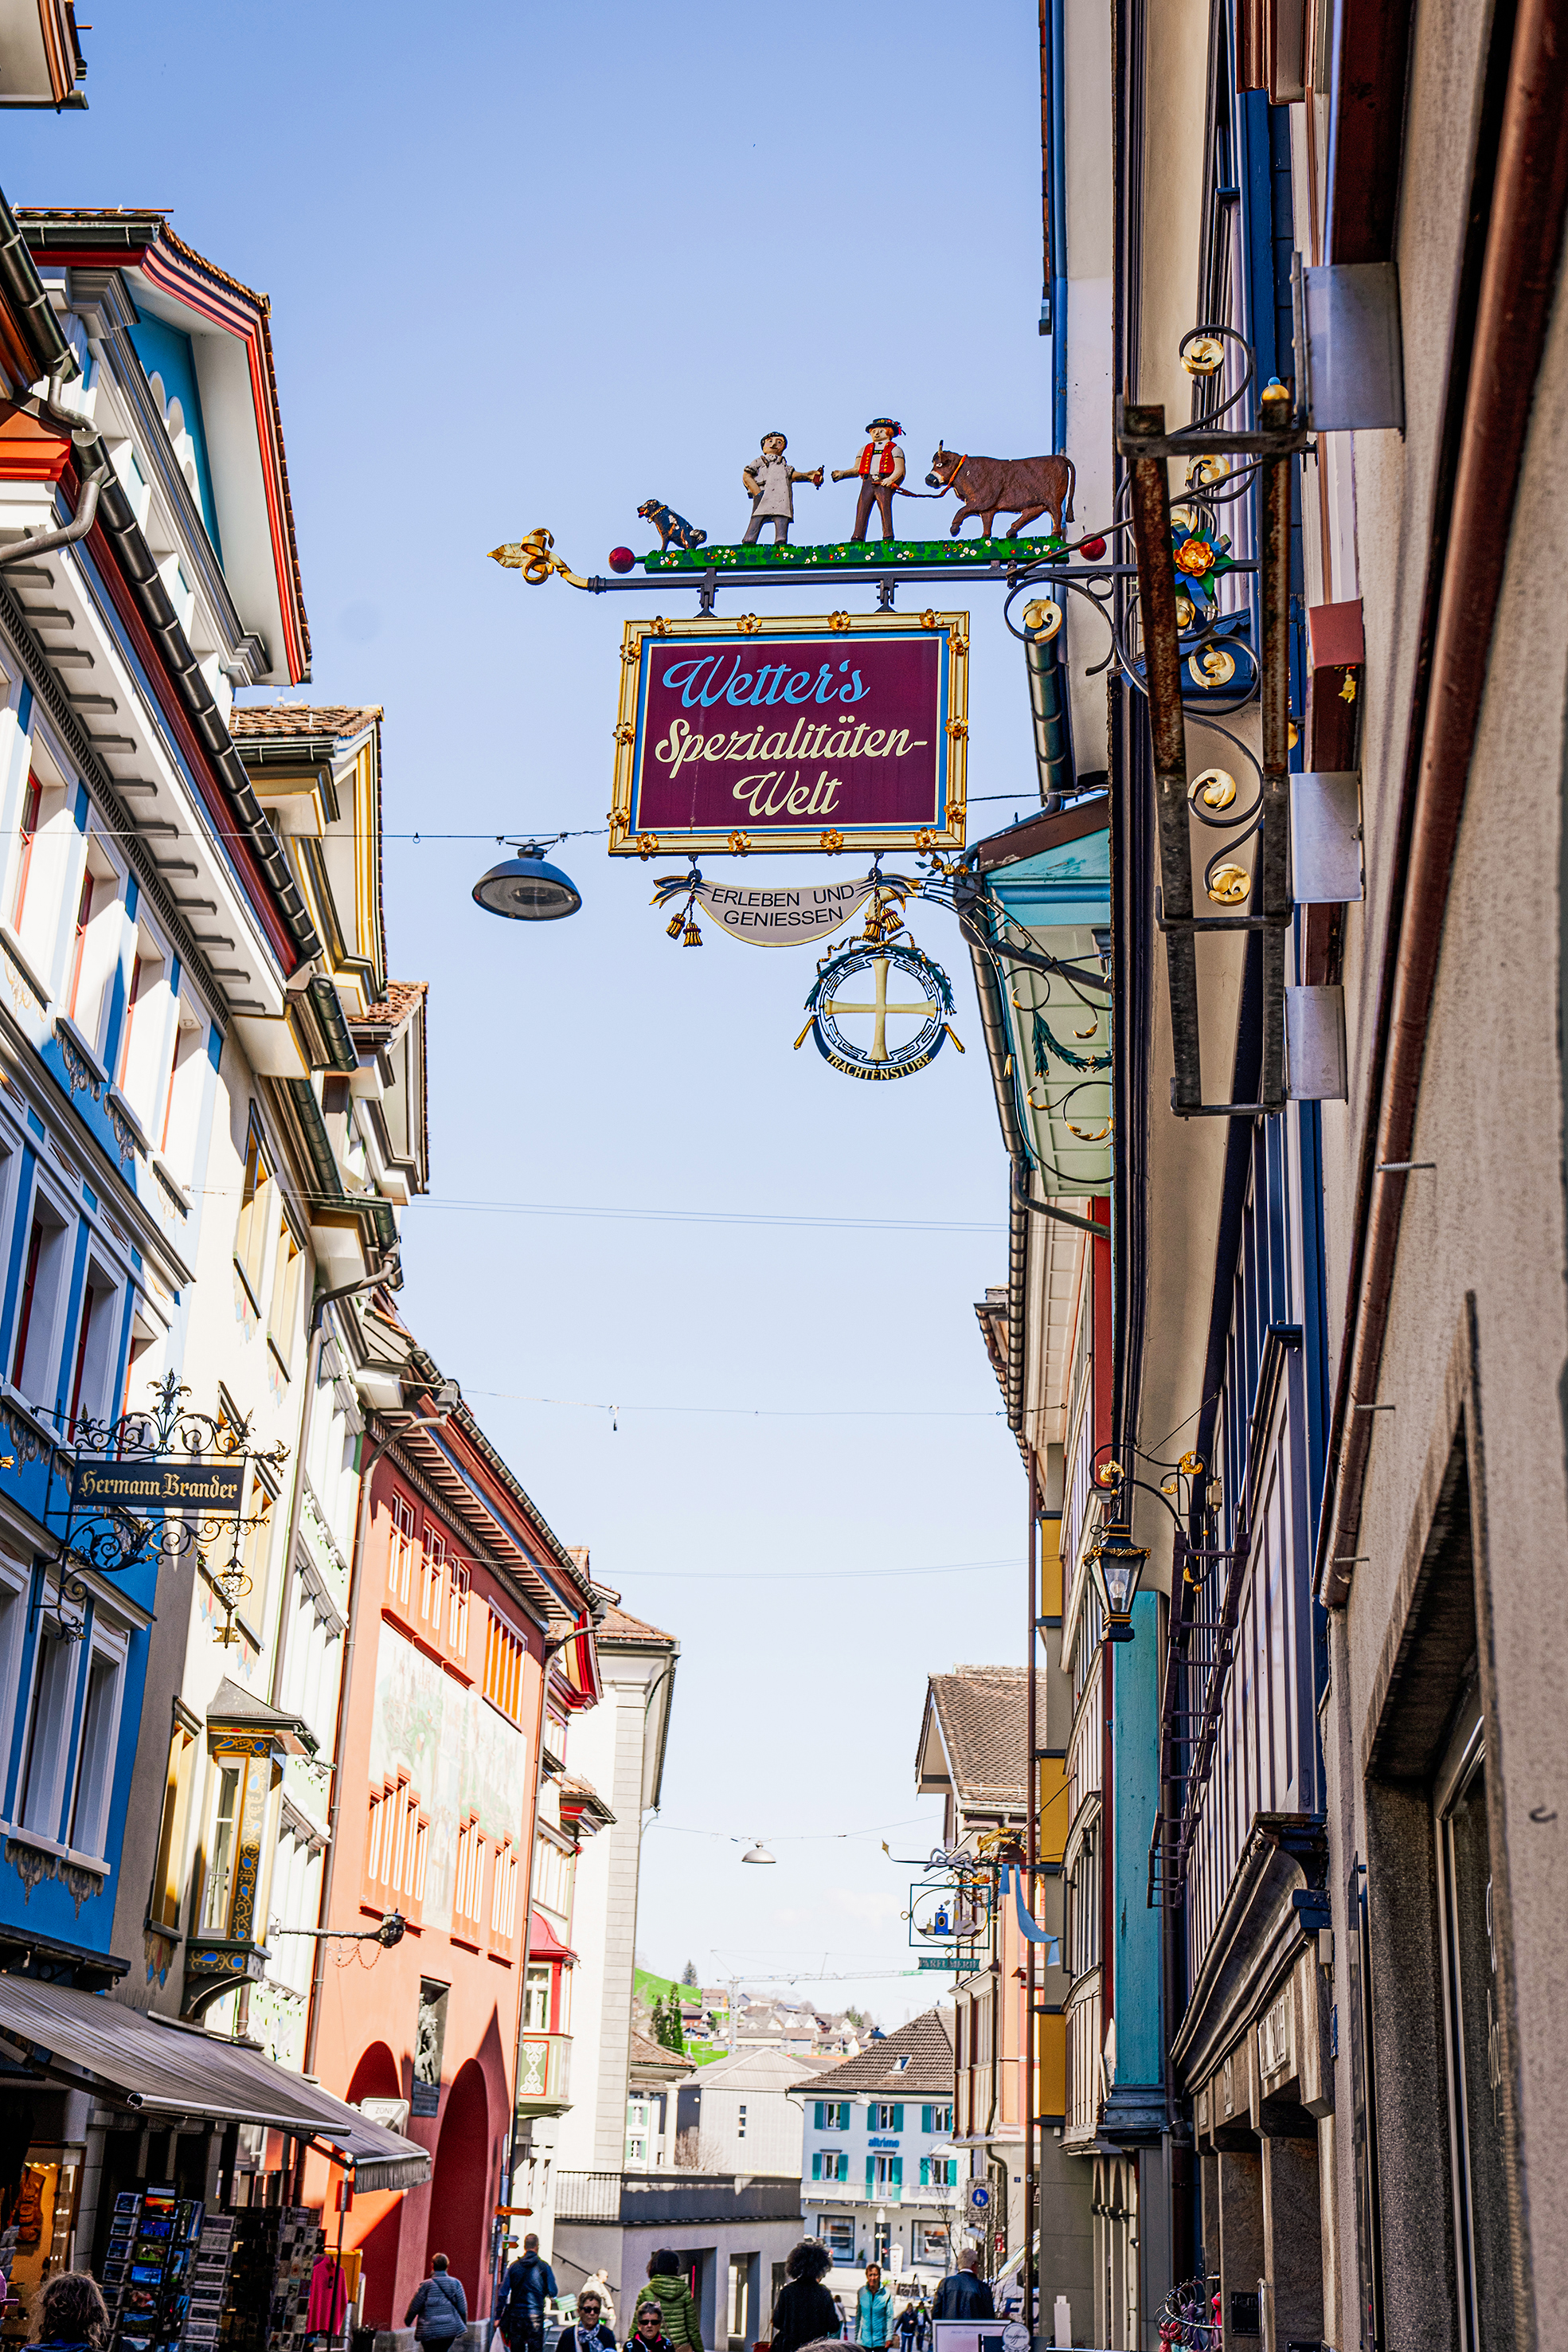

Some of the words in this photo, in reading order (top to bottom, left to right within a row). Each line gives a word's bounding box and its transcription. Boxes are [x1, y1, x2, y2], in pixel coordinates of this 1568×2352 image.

[662, 655, 870, 708] Wetter's
[655, 714, 929, 779] Spezialitäten-
[732, 770, 843, 816] Welt
[711, 888, 800, 907] ERLEBEN
[813, 885, 854, 904] UND
[723, 906, 843, 927] GENIESSEN
[826, 1051, 933, 1081] TRACHTENSTUBE
[78, 1470, 161, 1497] Hermann
[162, 1473, 238, 1499] Brander
[375, 2106, 393, 2115] ZONE
